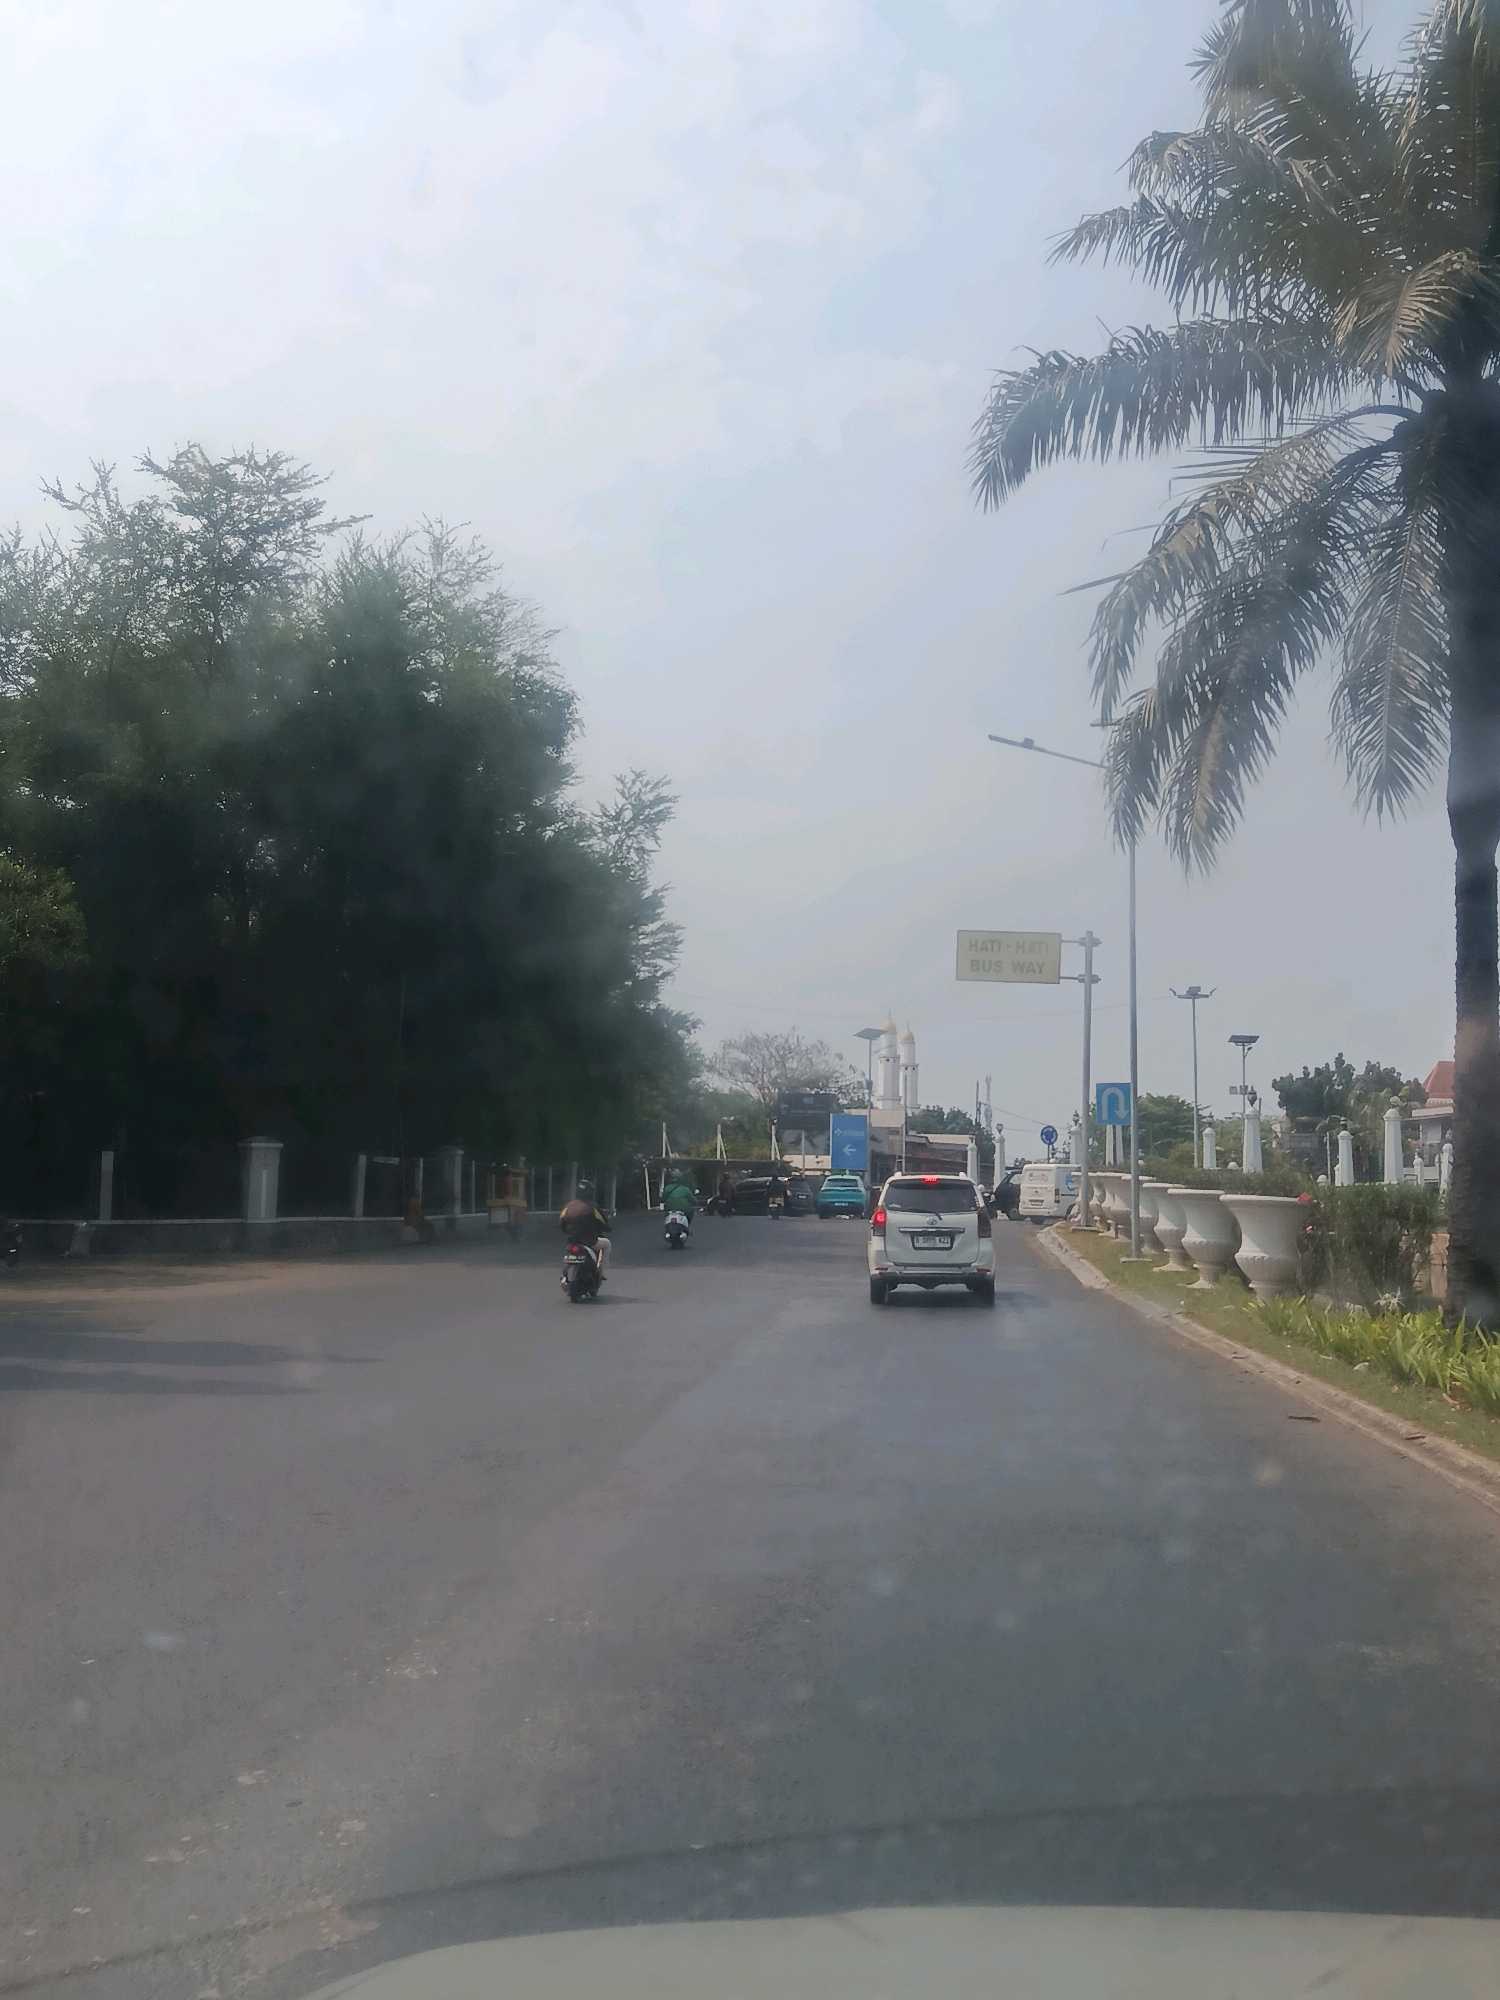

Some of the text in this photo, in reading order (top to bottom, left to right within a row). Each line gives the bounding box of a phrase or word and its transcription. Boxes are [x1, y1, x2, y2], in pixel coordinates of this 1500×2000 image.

[968, 939, 1002, 953] HATI
[1015, 940, 1050, 955] HATI
[970, 959, 1046, 975] BUS WAY
